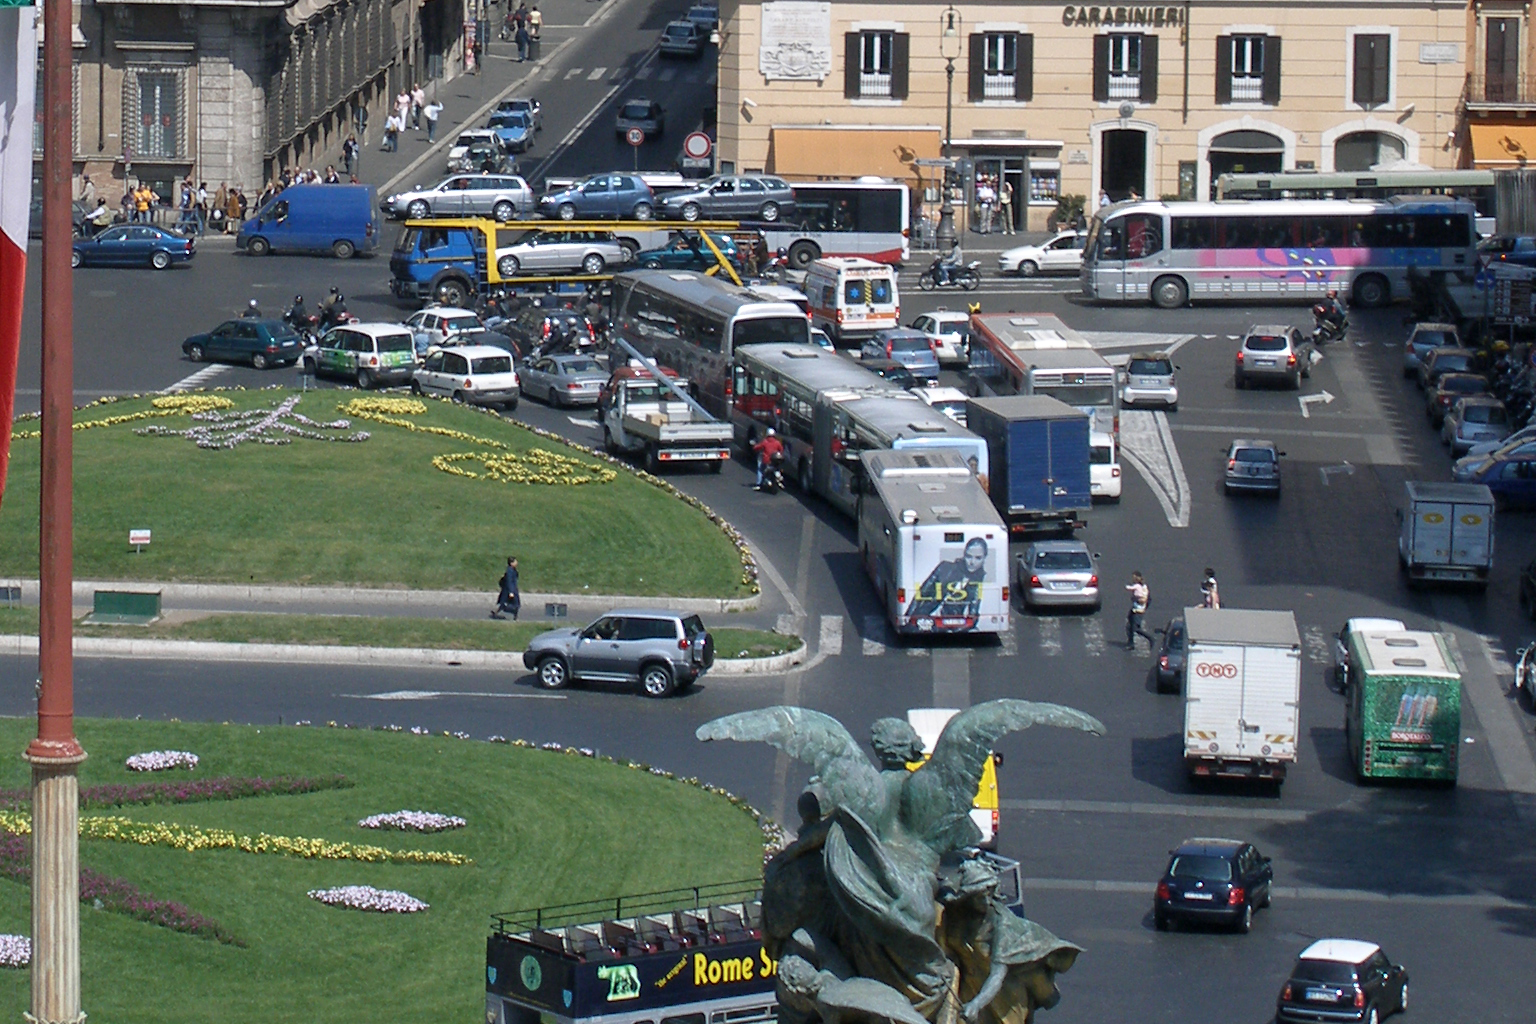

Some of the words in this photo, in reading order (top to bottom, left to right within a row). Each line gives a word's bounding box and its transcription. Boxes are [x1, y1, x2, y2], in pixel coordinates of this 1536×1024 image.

[1062, 5, 1184, 27] CARABINIERI
[914, 581, 993, 602] LIST
[1198, 664, 1235, 676] TNT
[694, 952, 755, 986] Rome
